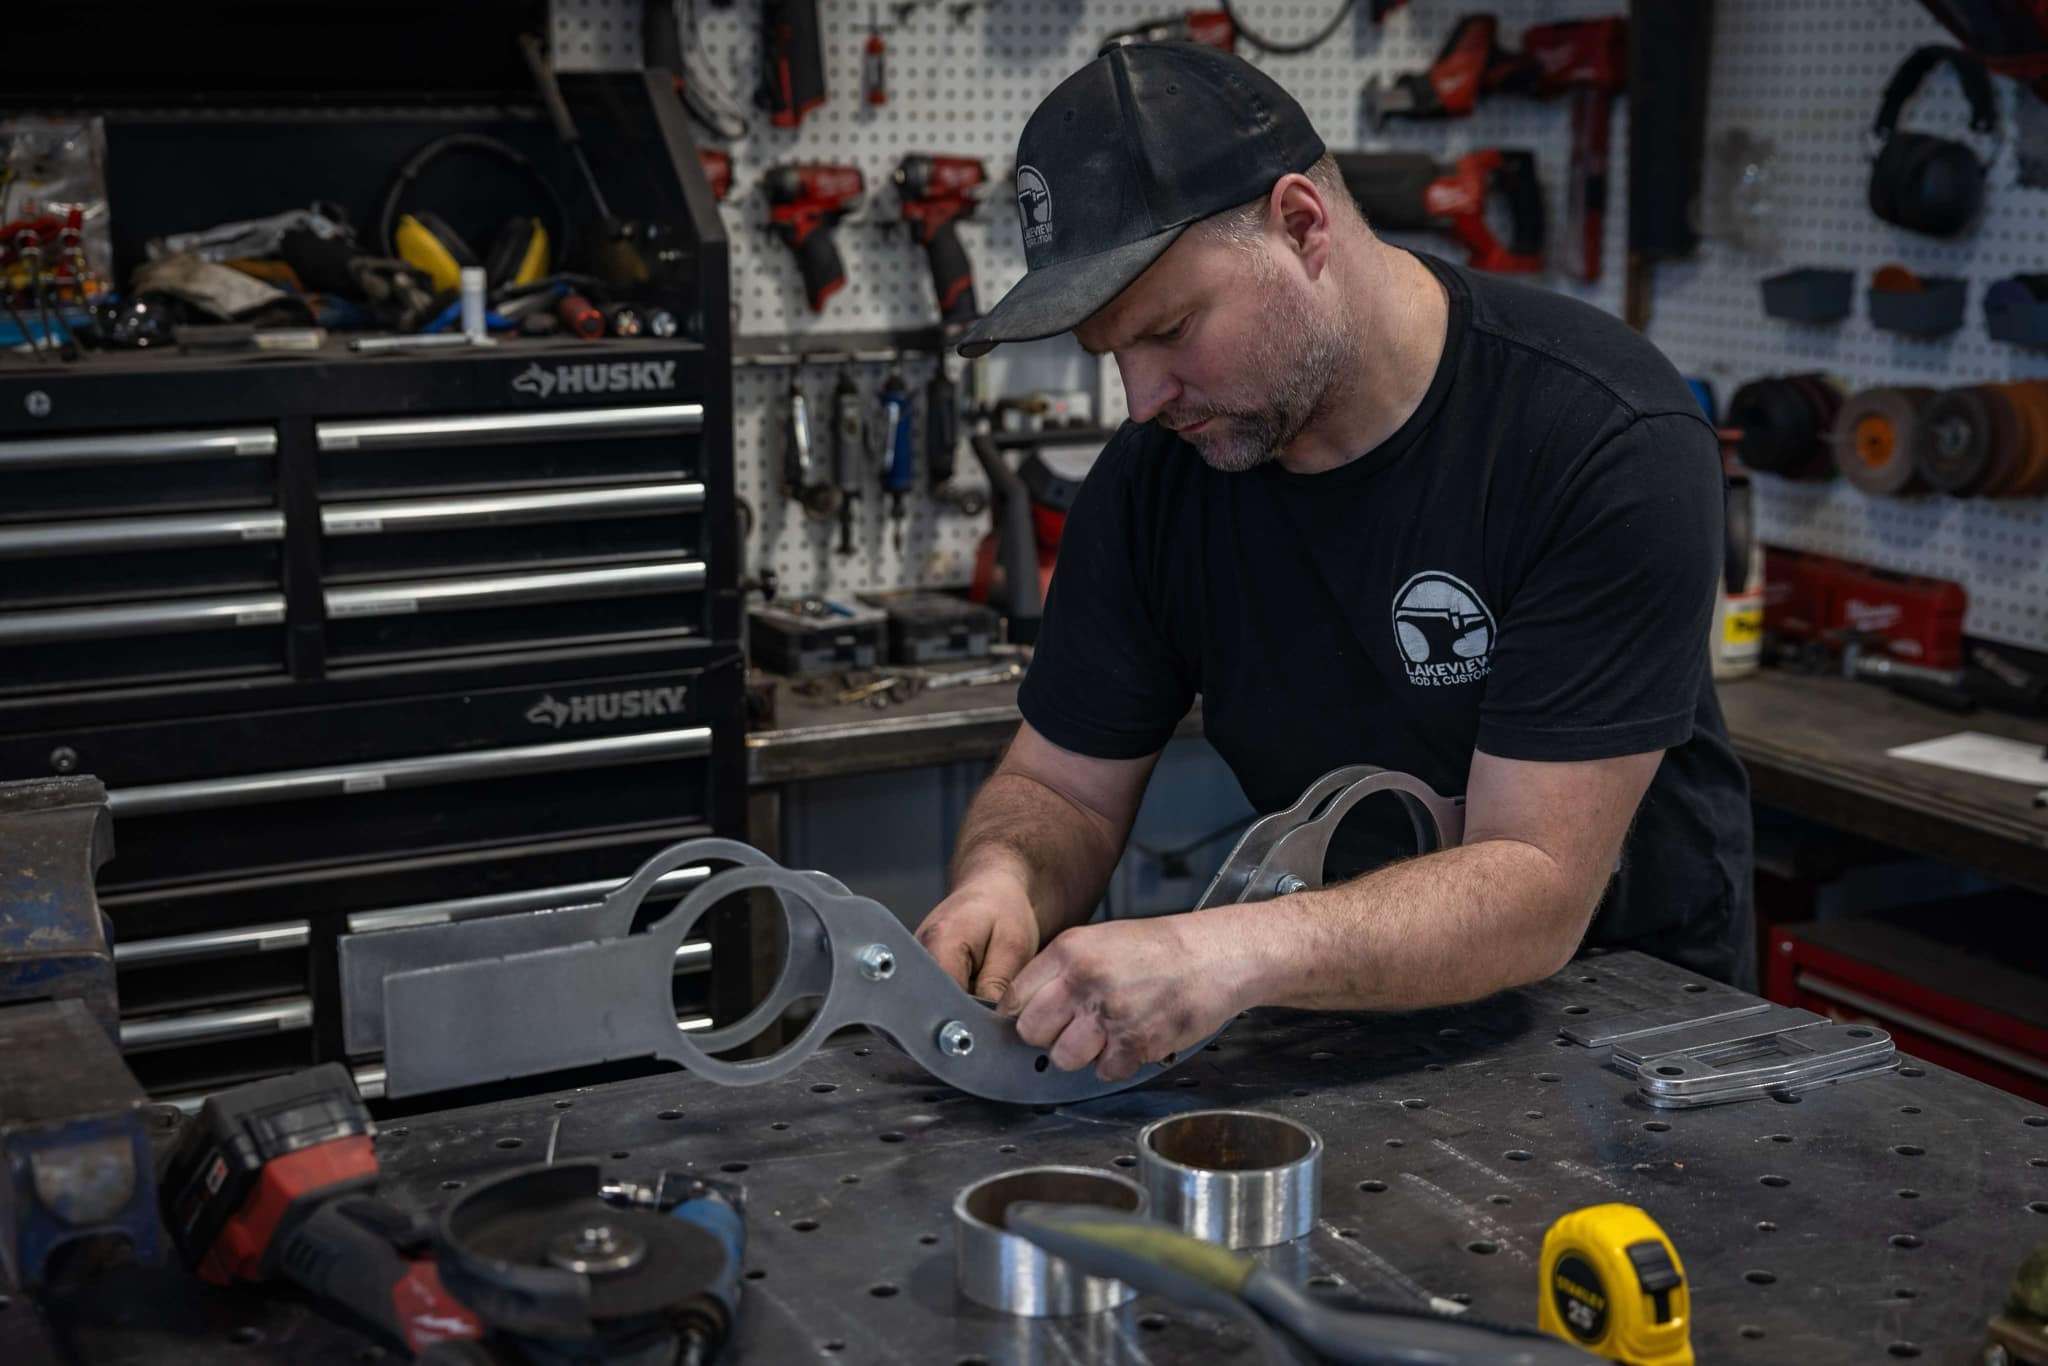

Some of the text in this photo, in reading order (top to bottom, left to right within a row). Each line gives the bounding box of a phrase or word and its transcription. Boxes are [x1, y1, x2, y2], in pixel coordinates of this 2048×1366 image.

[556, 359, 676, 394] HUSKY
[1410, 676, 1430, 687] ROD
[1433, 677, 1441, 687] &
[570, 685, 687, 723] HUSKY
